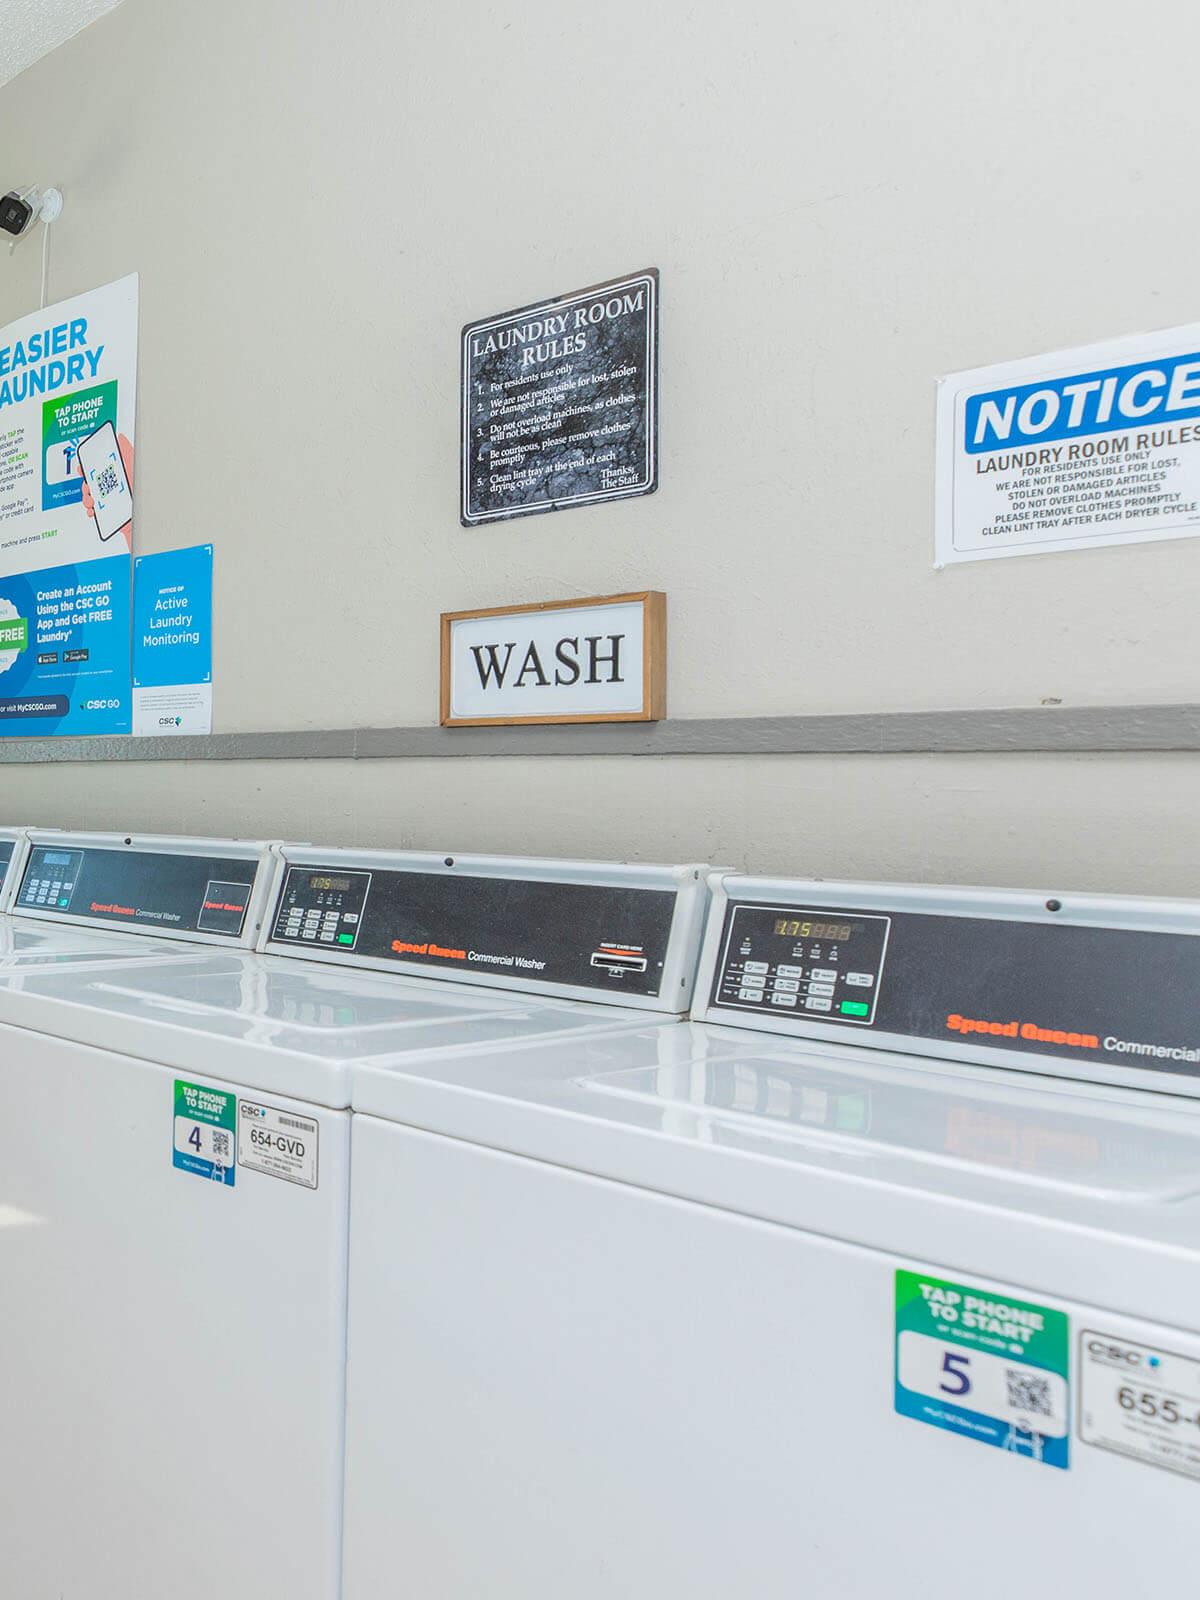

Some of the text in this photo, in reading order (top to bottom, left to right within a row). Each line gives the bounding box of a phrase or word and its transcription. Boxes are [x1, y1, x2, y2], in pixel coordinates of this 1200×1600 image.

[472, 290, 644, 357] LAUNDRY ROOM
[522, 332, 587, 367] RULES
[490, 382, 503, 392] For
[504, 373, 539, 389] residents
[540, 371, 554, 379] use
[555, 363, 574, 376] only
[490, 398, 503, 408] We
[503, 397, 516, 405] are
[517, 392, 530, 402] not
[531, 380, 576, 399] responsible
[577, 376, 591, 387] for
[611, 366, 637, 379] stolen
[55, 396, 103, 418] TAP PHONE
[490, 424, 502, 434] Do
[503, 421, 516, 431] not
[516, 412, 551, 427] overload
[594, 401, 604, 409] as
[605, 394, 636, 407] clothes
[500, 399, 534, 415] damaged
[536, 393, 565, 406] articles
[973, 362, 1200, 444] NOTICE
[58, 408, 99, 427] TO START
[490, 431, 505, 441] will
[506, 428, 519, 438] not
[520, 426, 530, 435] be
[541, 420, 562, 431] clean
[490, 450, 500, 459] Be
[542, 436, 567, 450] please
[568, 429, 600, 442] remove
[601, 422, 631, 435] clothes
[490, 453, 526, 470] promptly
[490, 474, 512, 484] Clean
[513, 470, 526, 479] lint
[528, 468, 544, 478] tray
[545, 465, 553, 473] at
[554, 461, 567, 471] the
[568, 455, 584, 469] end
[586, 455, 595, 464] of
[596, 450, 616, 463] each
[976, 447, 1063, 474] LAUNDRY
[1068, 436, 1129, 460] ROOM
[1022, 450, 1151, 476] FOR RESIDENTS USE ONLY
[490, 476, 537, 493] drying cycle
[601, 473, 639, 489] The Staff
[996, 481, 1010, 491] WE
[1012, 479, 1031, 489] ARE
[1033, 476, 1052, 486] NOT
[1055, 465, 1125, 483] RESPONSIBLE
[1127, 462, 1148, 473] FOR
[1008, 471, 1166, 500] STOLEN OR DAMAGED ARTICLES
[995, 493, 1181, 523] PLEASE REMOVE CLOTHES PROMPTLY
[1012, 483, 1161, 511] DO NOT OVERLOAD MACHINES
[982, 502, 1197, 536] CLEAN LINT TRAY AFTER EACH DRYER CYCLE
[36, 580, 112, 601] Create an Account
[36, 595, 109, 616] Using the CSC GO
[155, 598, 188, 611] Active
[36, 609, 112, 631] App and Get FREE
[150, 614, 192, 629] Laundry
[0, 627, 25, 642] FREE
[143, 631, 200, 647] Monitoring
[469, 634, 625, 690] WASH
[86, 698, 120, 709] CSC GO
[159, 717, 174, 725] CSC
[391, 940, 546, 970] Speed Queen Commercial Washer
[947, 1013, 1200, 1062] Speed Queen Commercial
[183, 1086, 227, 1106] TAP PHONE
[185, 1096, 196, 1107] TO
[198, 1101, 223, 1115] START
[241, 1104, 260, 1116] CSC
[188, 1126, 202, 1152] 4
[250, 1129, 305, 1157] 654-GVD
[919, 1283, 1044, 1331] TAP PHONE
[928, 1301, 958, 1322] TO
[961, 1311, 1034, 1343] START
[1088, 1340, 1141, 1365] CSC
[938, 1351, 973, 1396] 5
[1118, 1387, 1200, 1428] 655-
